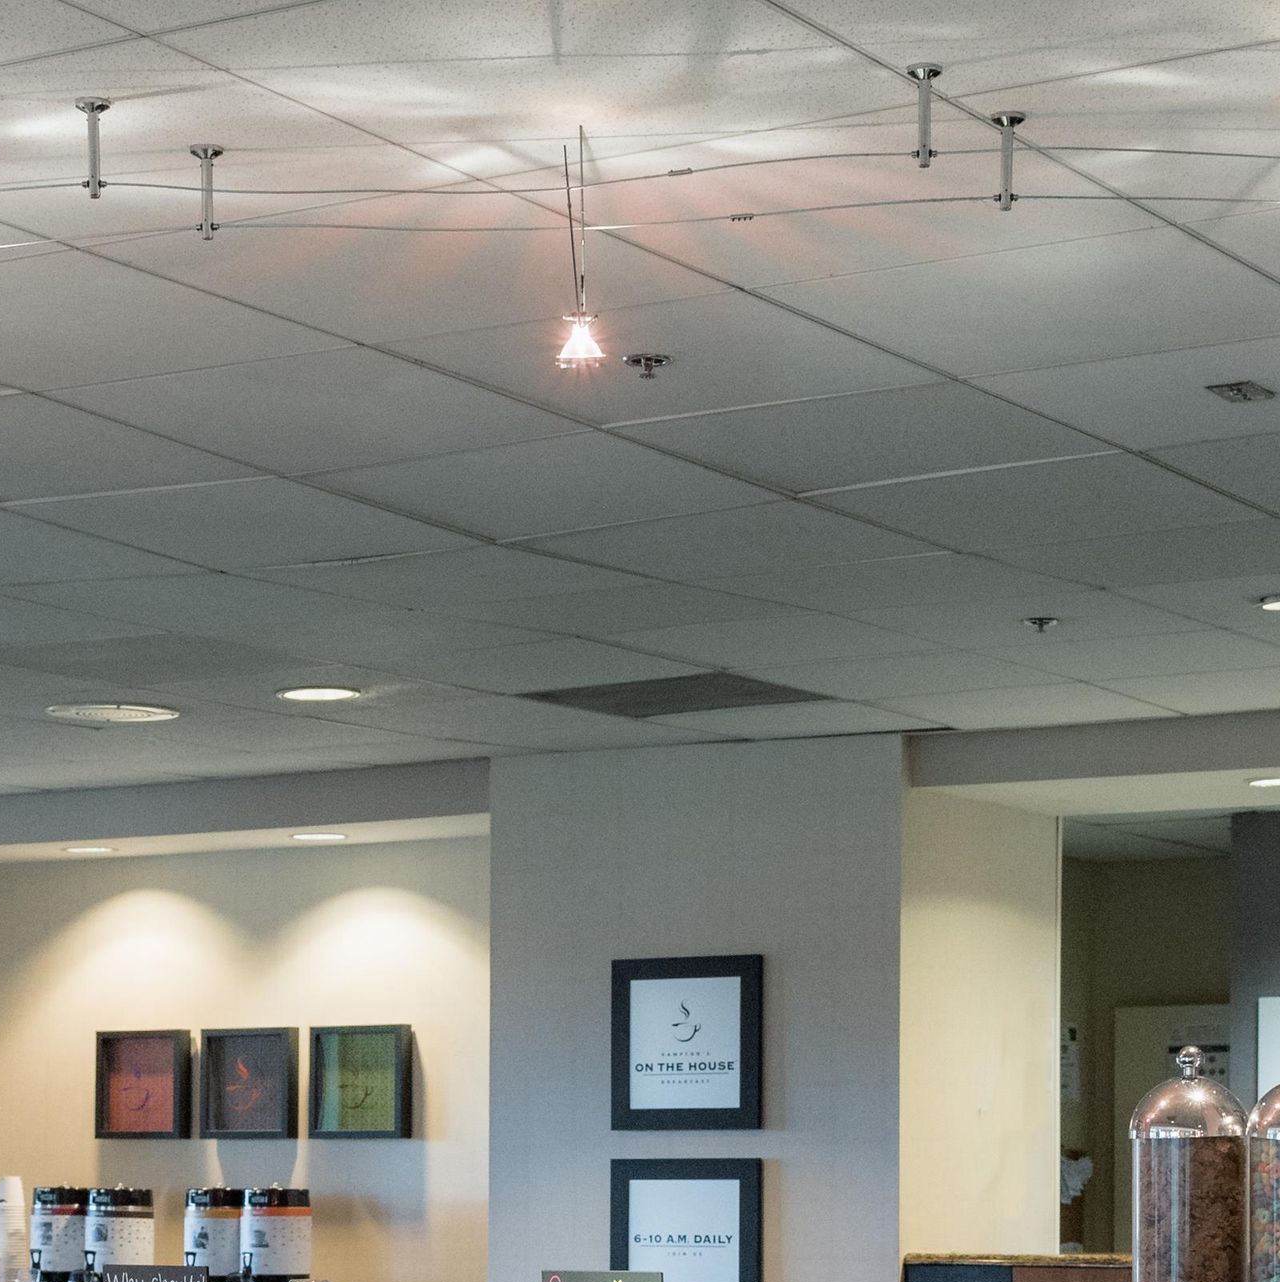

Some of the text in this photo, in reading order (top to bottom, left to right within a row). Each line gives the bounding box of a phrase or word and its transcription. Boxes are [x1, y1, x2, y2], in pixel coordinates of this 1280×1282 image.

[635, 1061, 735, 1072] ON THE HOUSE
[634, 1234, 662, 1243] 6-10
[694, 1234, 733, 1244] DAILY
